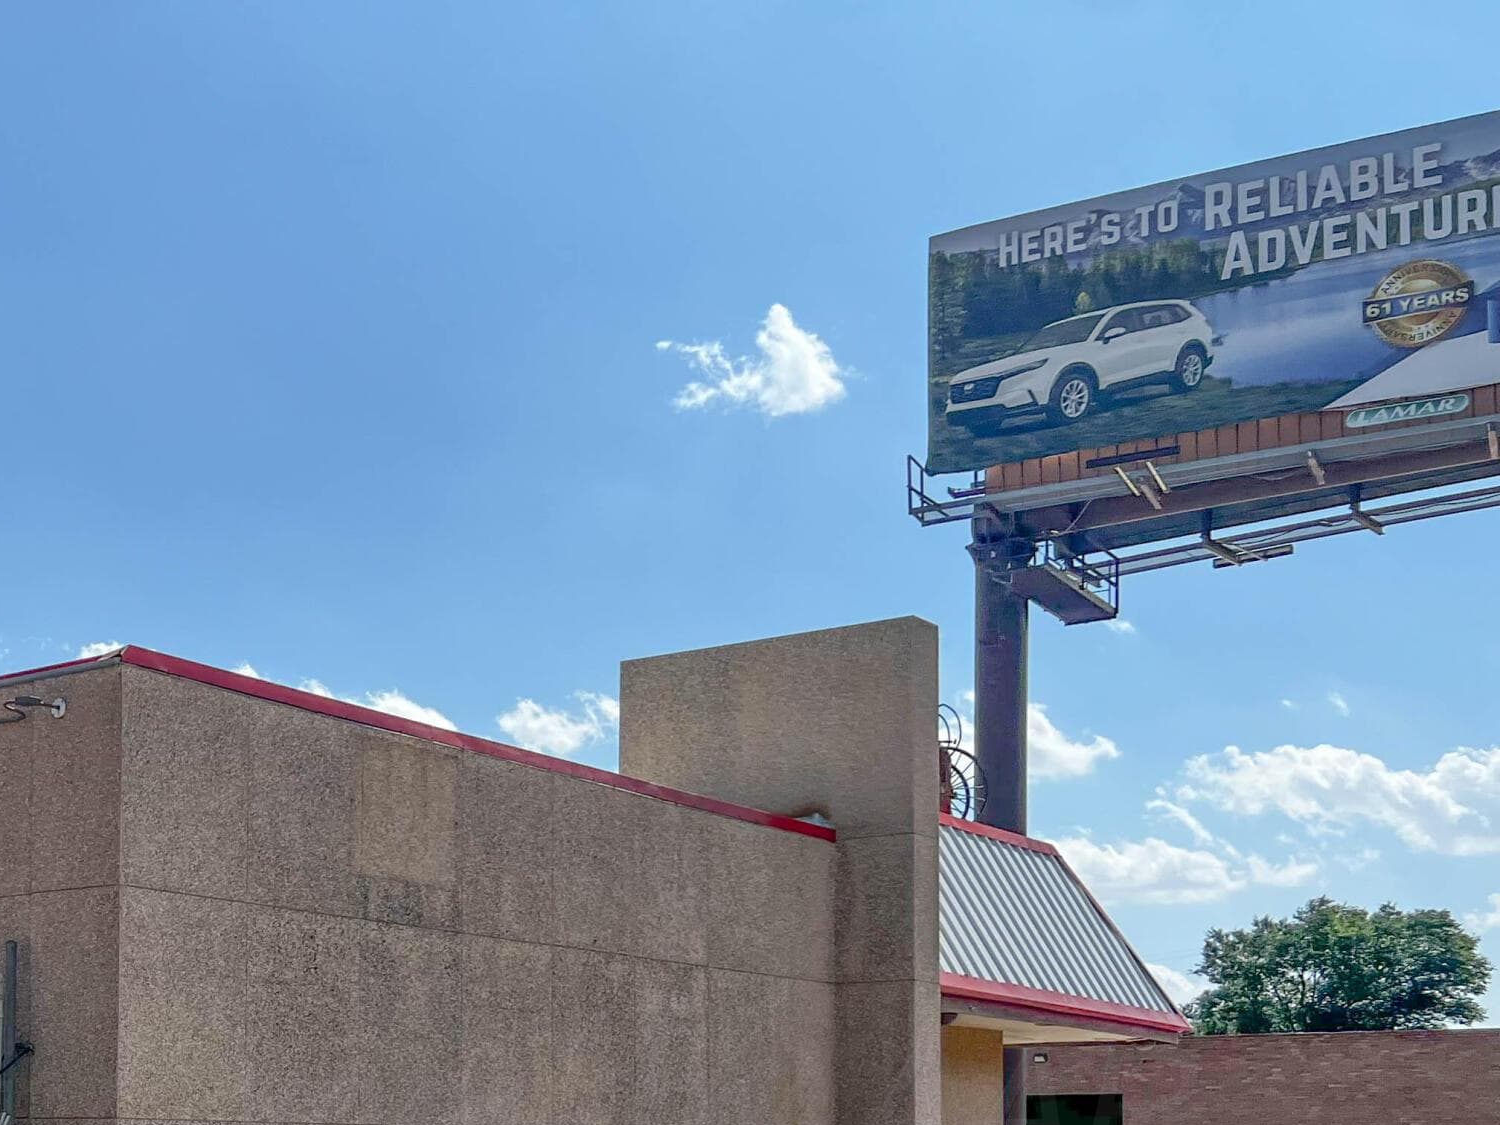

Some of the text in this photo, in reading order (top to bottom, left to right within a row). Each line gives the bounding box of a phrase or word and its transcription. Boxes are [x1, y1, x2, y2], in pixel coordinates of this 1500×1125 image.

[999, 144, 1443, 267] HERE'S TO RELIABLE
[1221, 184, 1500, 279] ADVENTUR
[1366, 288, 1469, 318] 61 YEARS
[1356, 398, 1455, 424] LAMAR
